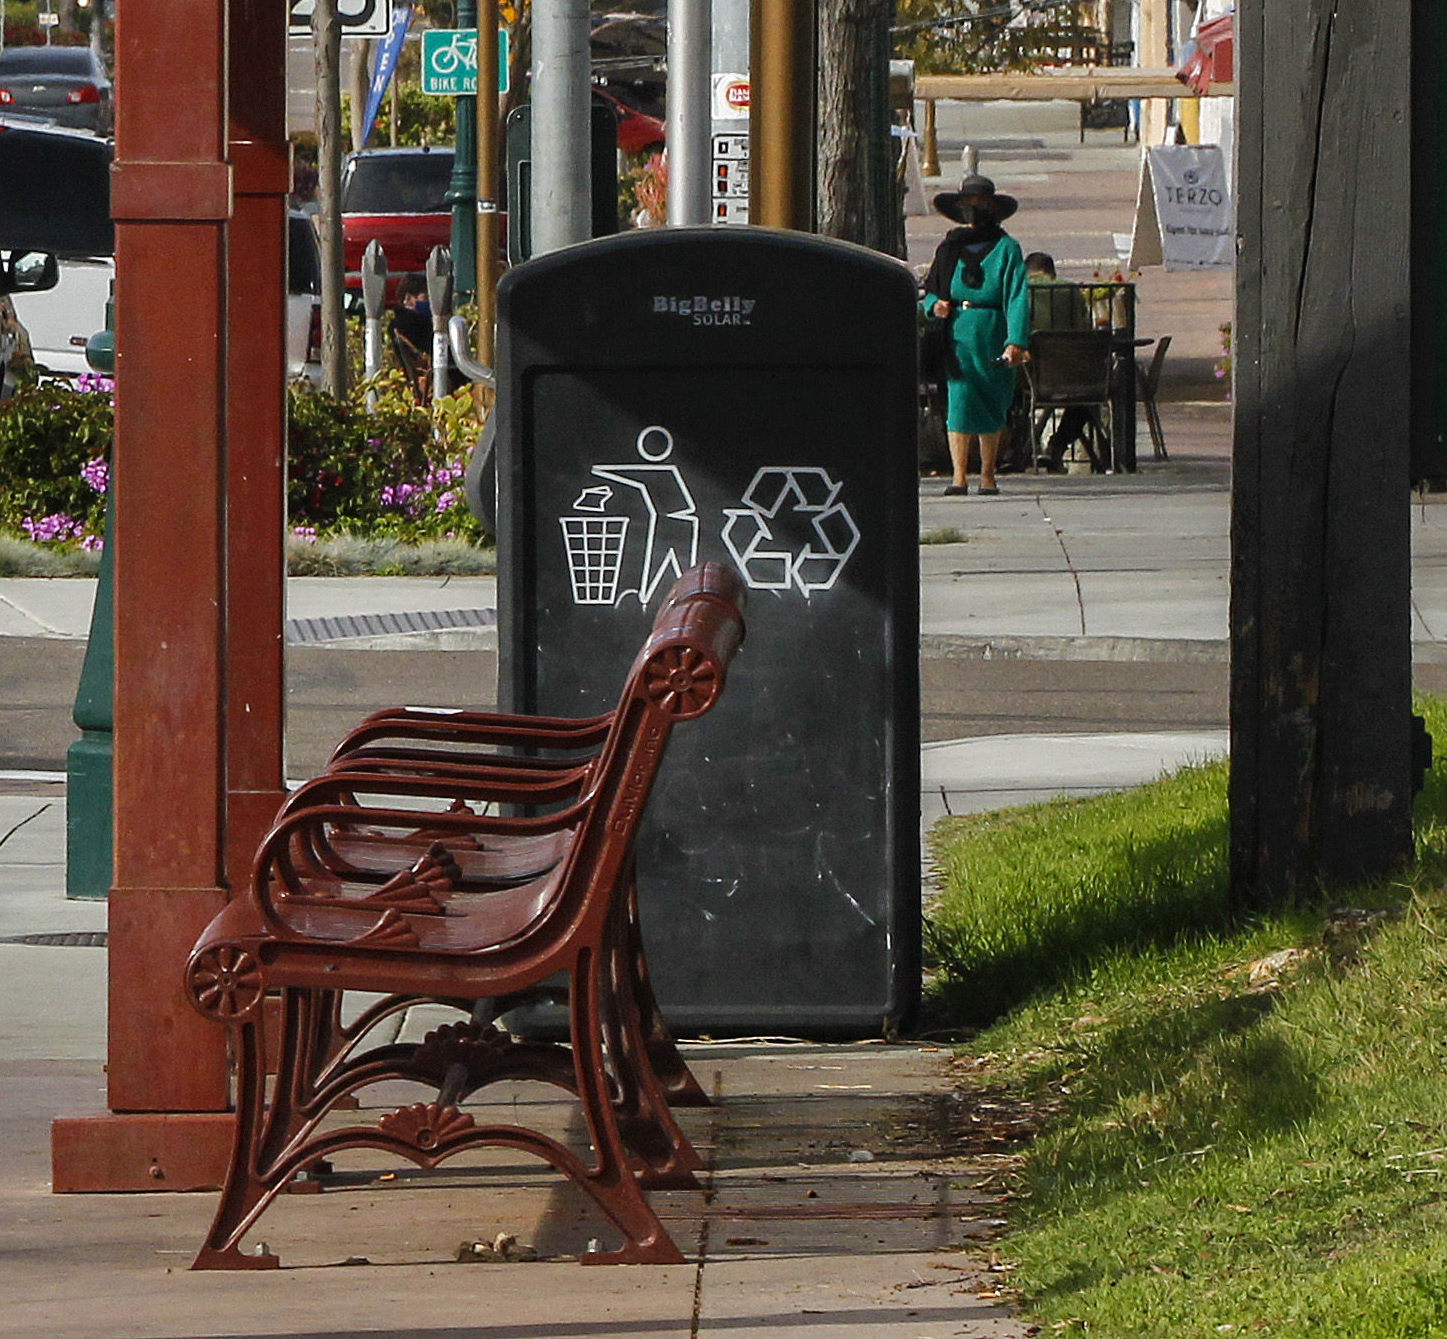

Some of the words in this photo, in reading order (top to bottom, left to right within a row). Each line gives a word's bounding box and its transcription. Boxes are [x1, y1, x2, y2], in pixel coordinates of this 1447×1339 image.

[430, 77, 457, 91] BIKE
[1165, 186, 1223, 207] TERZO
[652, 295, 756, 316] BigBelly
[692, 313, 742, 326] SOLAR
